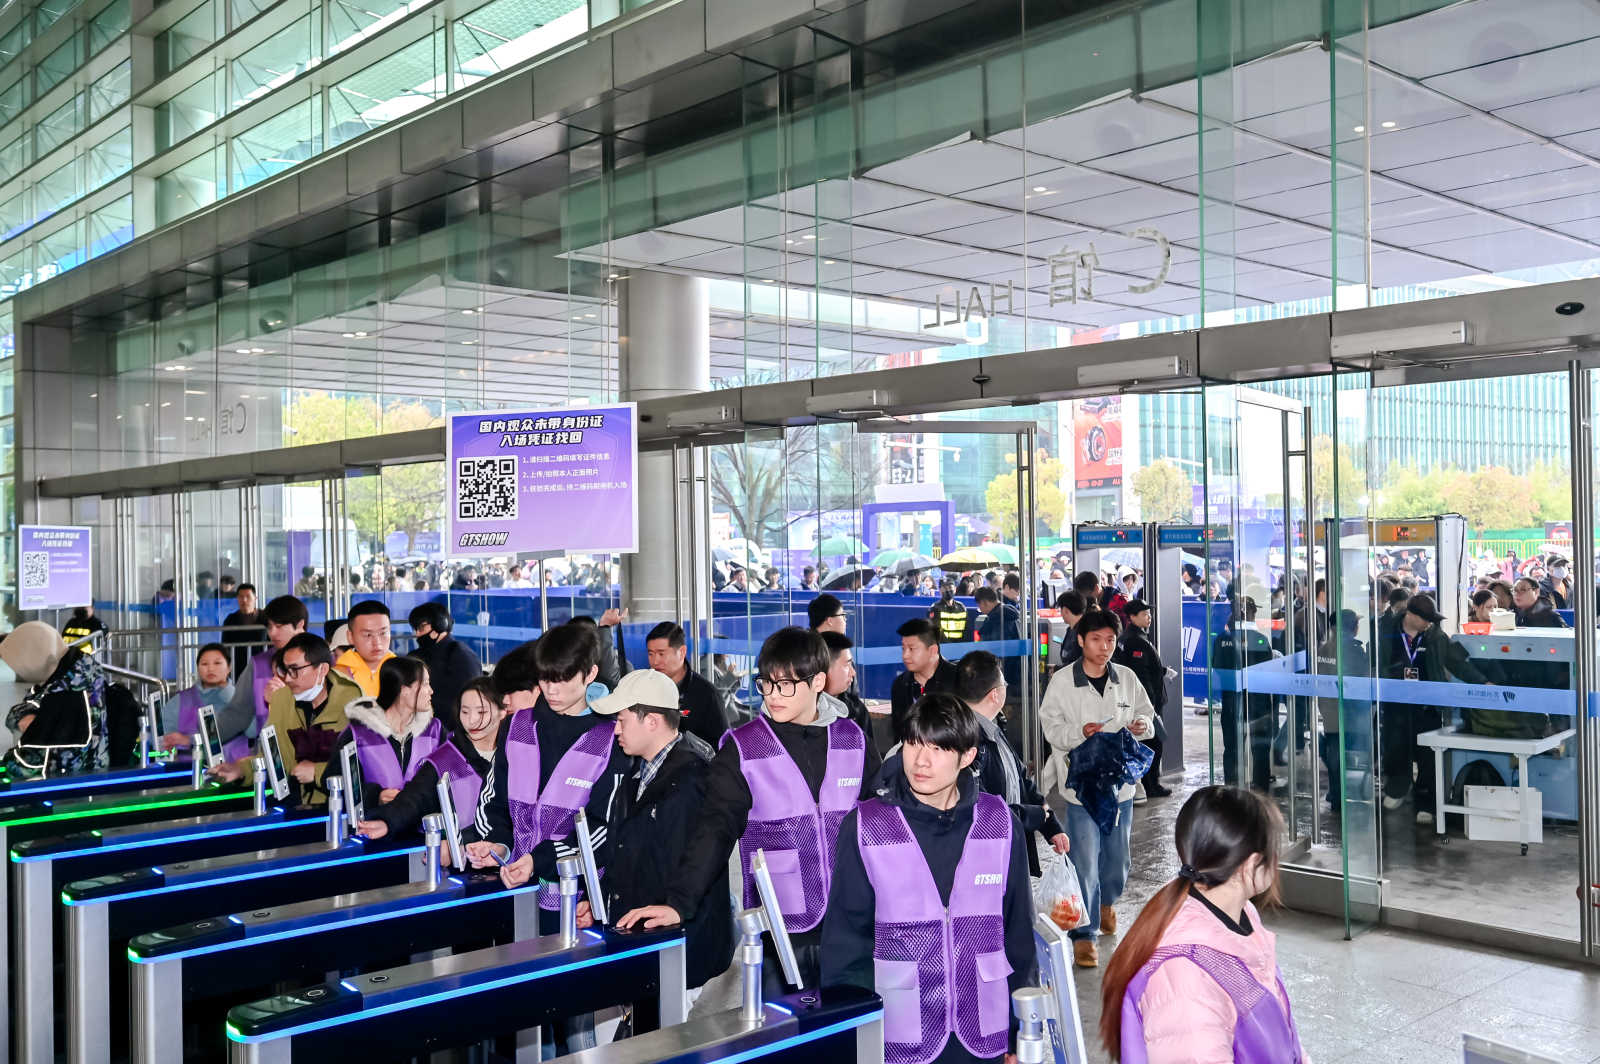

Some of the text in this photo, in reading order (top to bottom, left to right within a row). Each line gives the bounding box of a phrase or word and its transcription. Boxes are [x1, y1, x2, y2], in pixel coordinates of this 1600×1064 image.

[479, 415, 604, 433] 国内观众未带身份证
[500, 431, 583, 447] 入场凭证找回
[459, 532, 510, 547] GTSHOW
[565, 776, 594, 790] GTSHOW
[974, 873, 1003, 885] GTSHO
